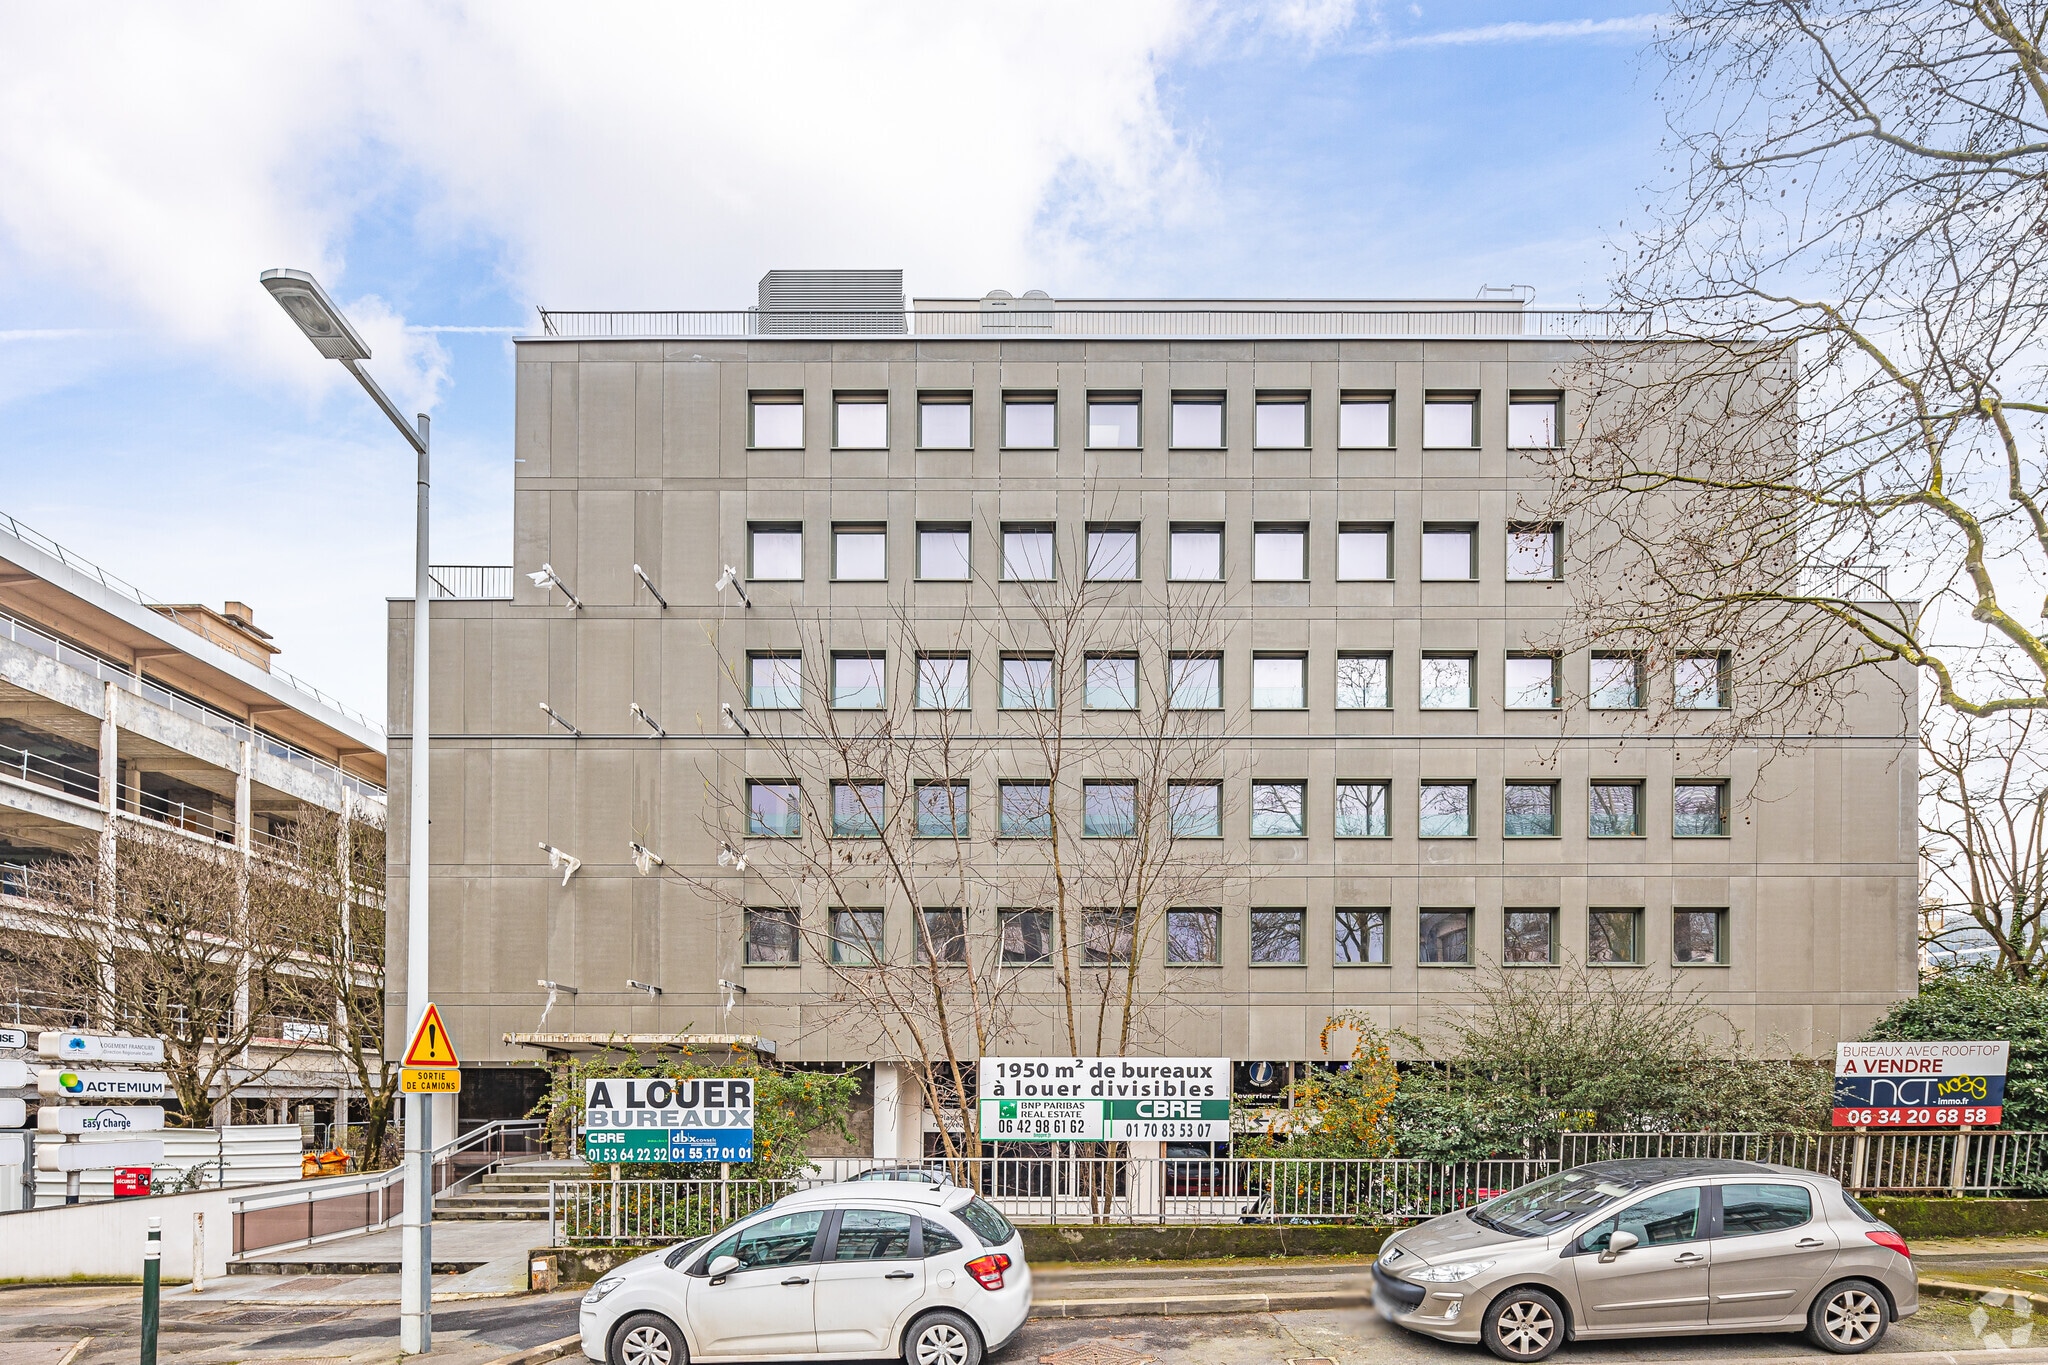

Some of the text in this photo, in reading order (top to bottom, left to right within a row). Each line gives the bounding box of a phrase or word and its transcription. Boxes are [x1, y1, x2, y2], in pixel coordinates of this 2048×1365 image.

[1843, 1045, 2000, 1057] BUREAUX AVEC ROOFTOP
[996, 1059, 1213, 1078] 1950 m² de bureaux
[1843, 1059, 1944, 1073] A VENDRE
[418, 1072, 446, 1080] SORTIE
[86, 1081, 163, 1093] ACTEMIUM
[406, 1082, 456, 1090] DE CAMIONS
[993, 1080, 1005, 1097] à
[1016, 1080, 1081, 1097] louer
[1090, 1080, 1214, 1097] divisibles
[588, 1081, 751, 1109] A LOUER
[1021, 1110, 1082, 1118] REAL ESTATE
[1135, 1100, 1202, 1118] CBRE
[588, 1110, 751, 1127] BUREAUX
[1848, 1109, 1987, 1124] 06 34 20 68 58
[82, 1117, 131, 1131] Easy Charge
[998, 1119, 1085, 1133] 06 42 98 61 62
[1126, 1123, 1211, 1138] 01 70 83 53 07
[588, 1133, 626, 1143] CBRE
[588, 1148, 667, 1161] 01 53 64 22 32
[672, 1147, 751, 1159] 01 55 17 01 01
